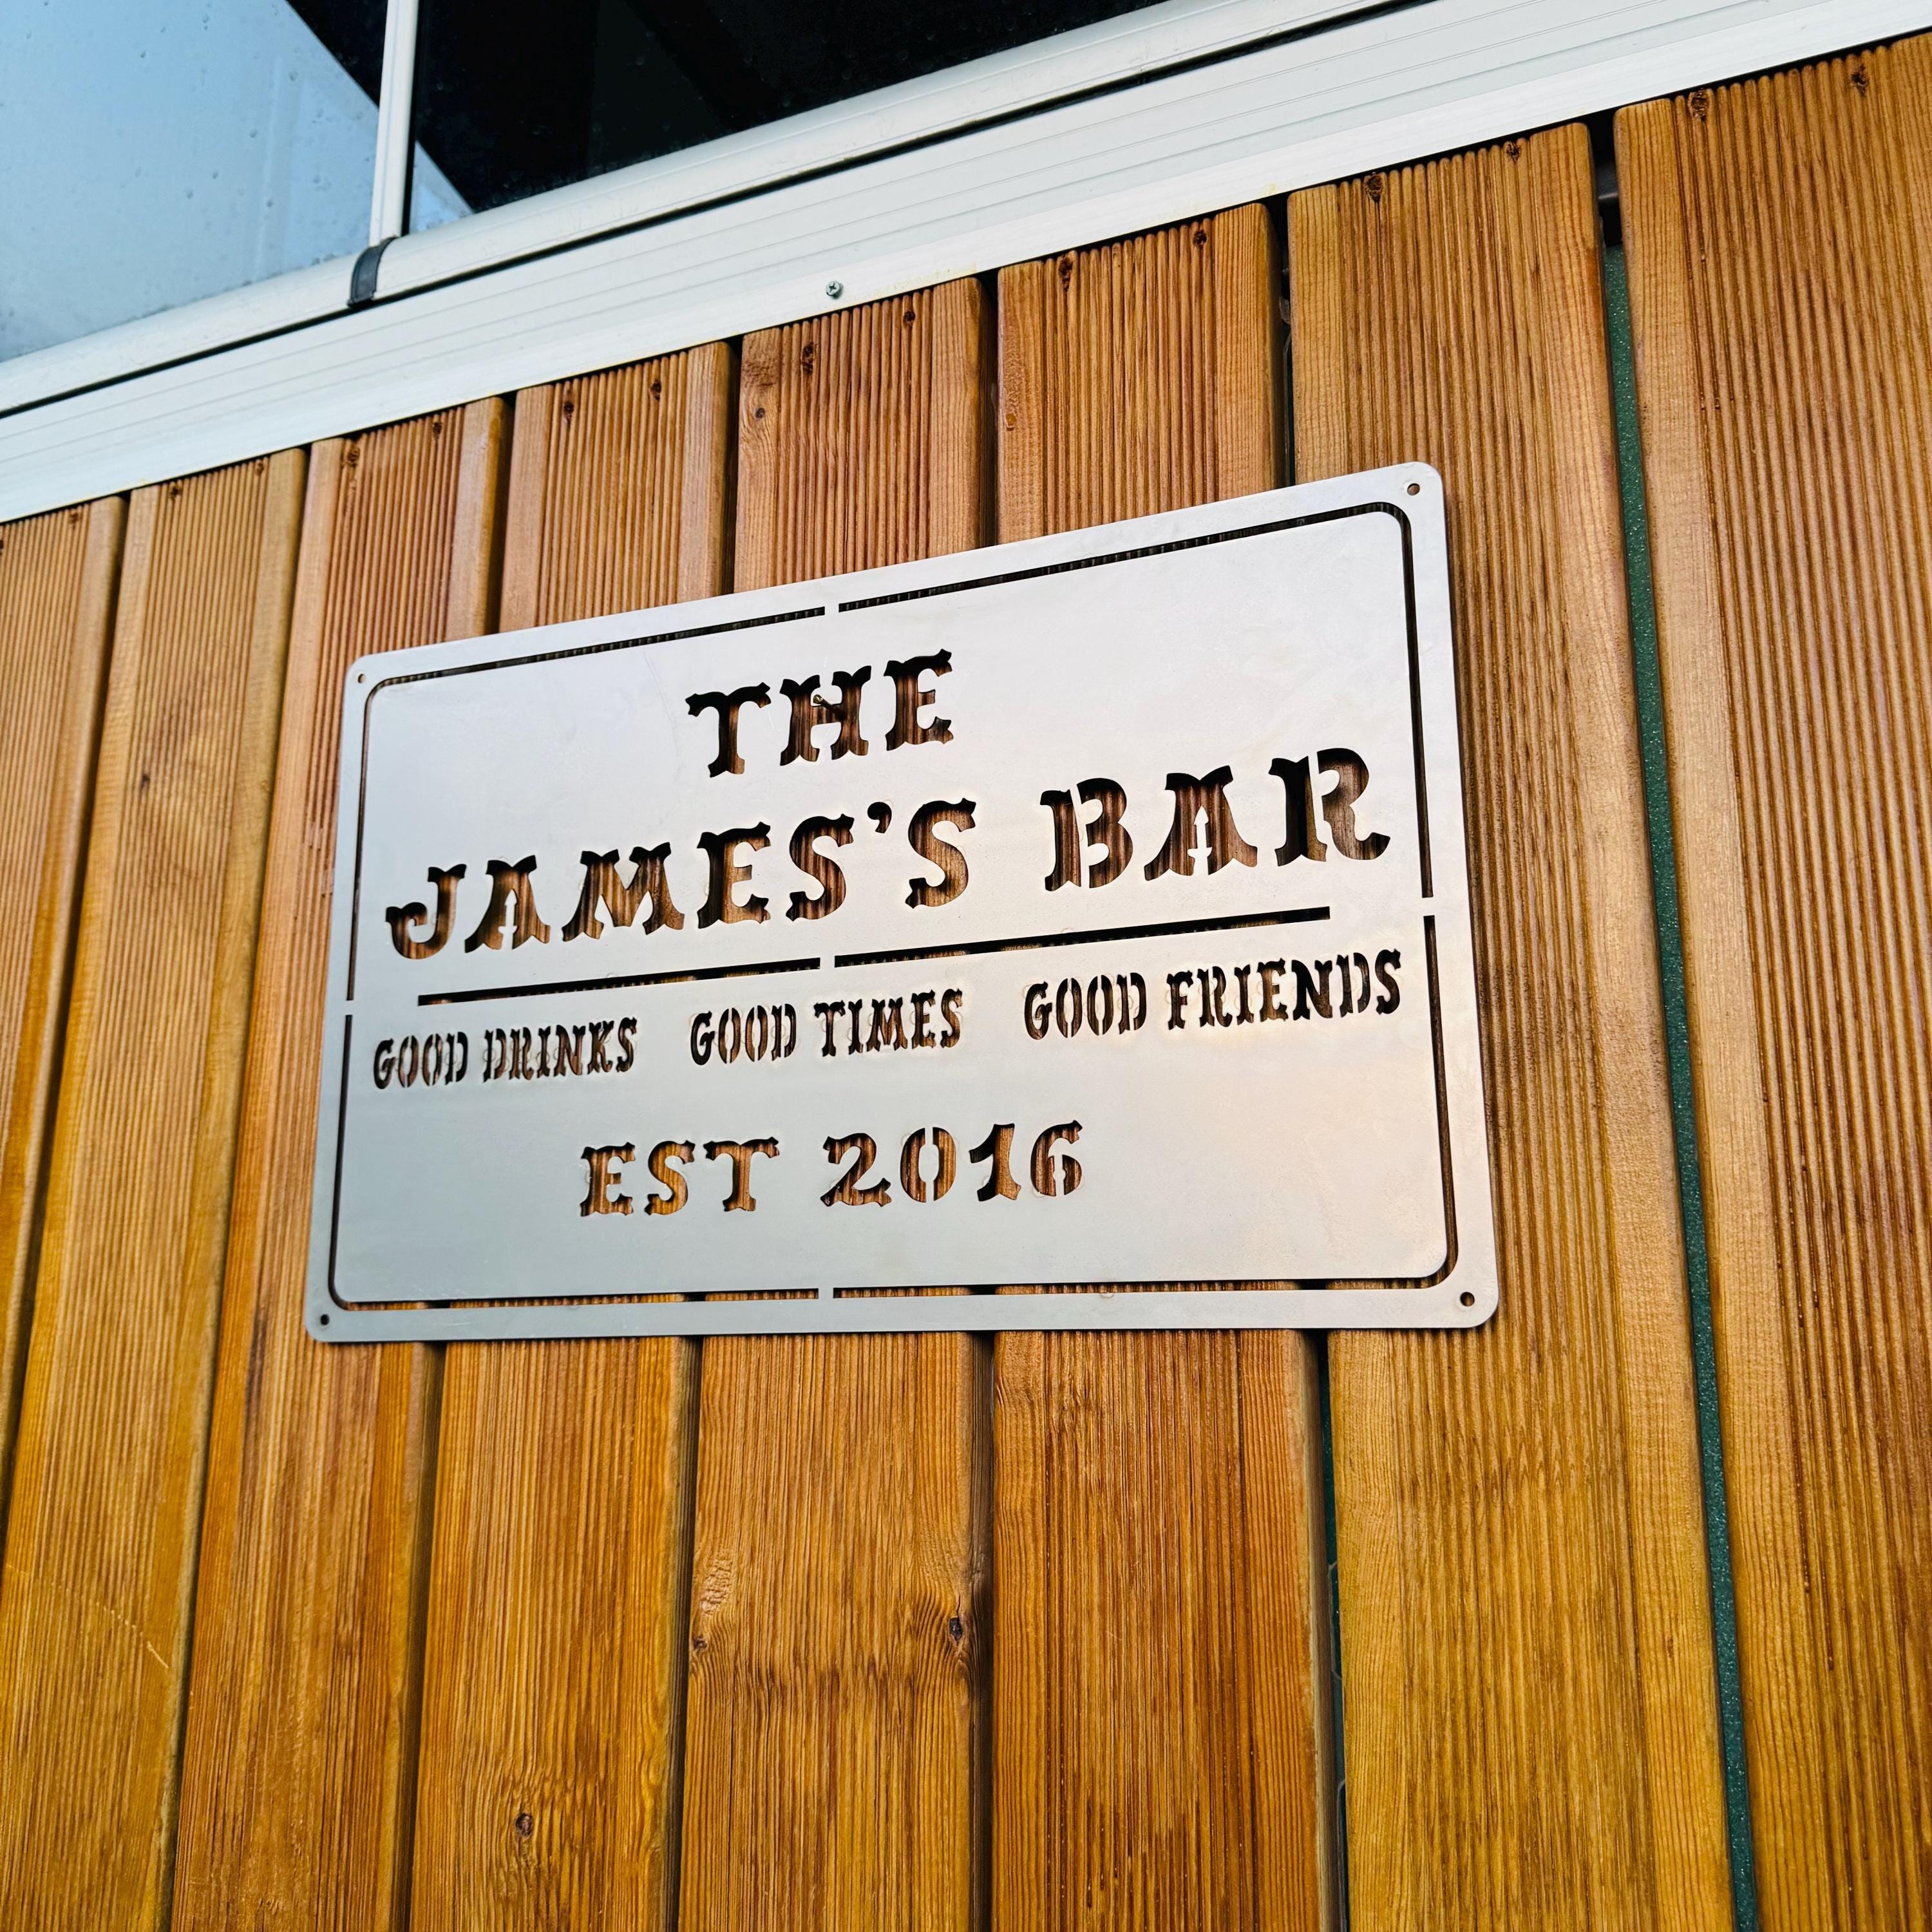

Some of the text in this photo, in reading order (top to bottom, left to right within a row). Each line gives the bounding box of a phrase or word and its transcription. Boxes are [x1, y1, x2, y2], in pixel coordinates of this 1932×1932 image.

[685, 649, 953, 777] THE
[385, 748, 1390, 959] JAMES'S BAR
[373, 949, 1401, 1089] GOOD DRINKS GOOD TIMES GOOD FRIENDS
[580, 1120, 1083, 1217] EST 2016
